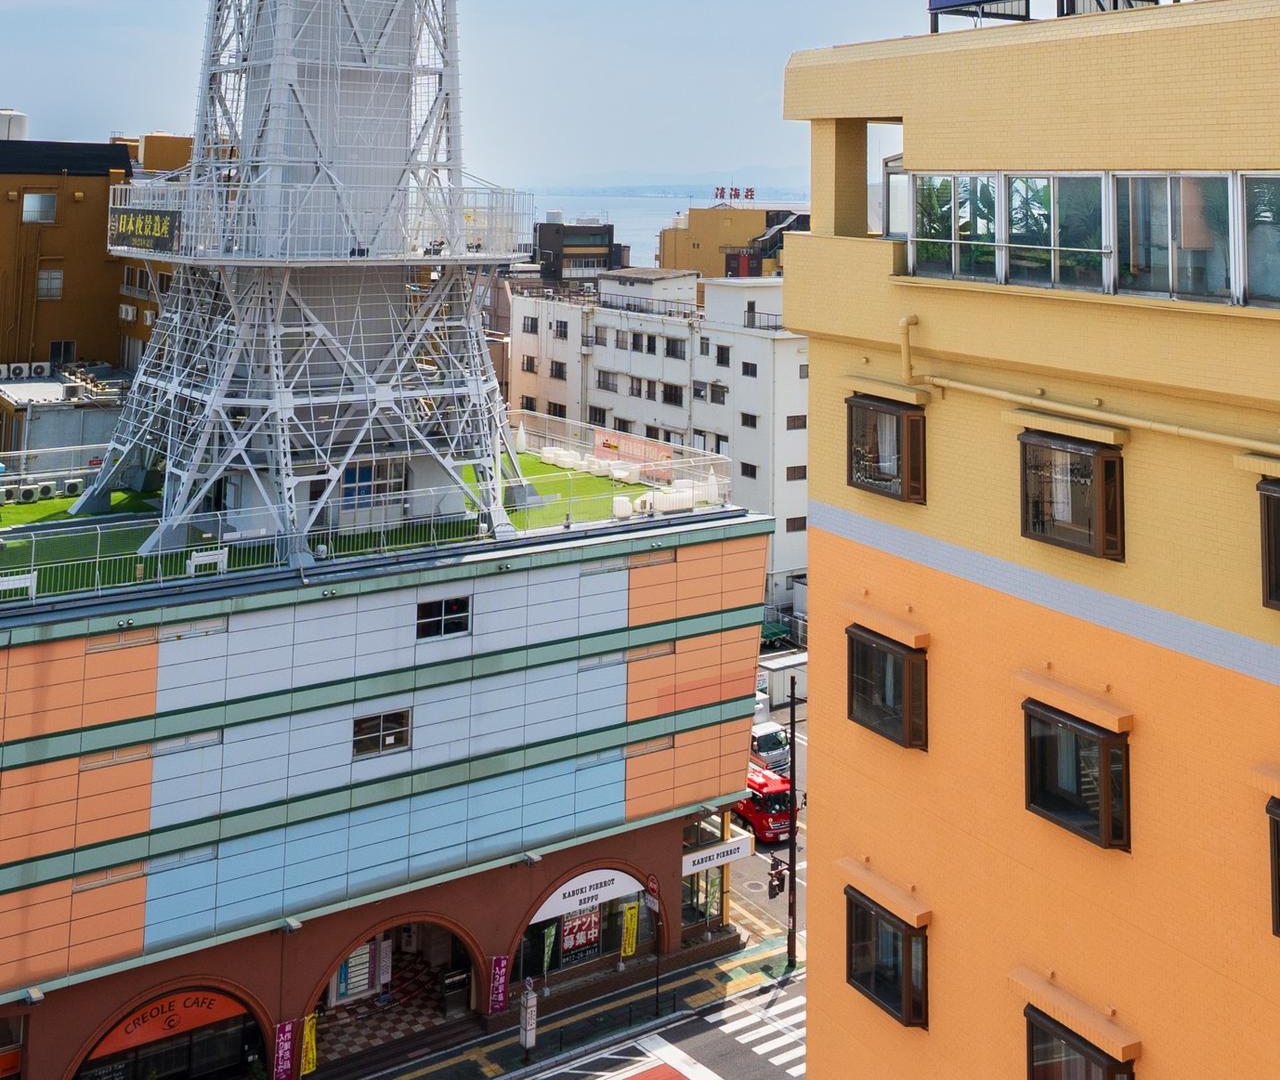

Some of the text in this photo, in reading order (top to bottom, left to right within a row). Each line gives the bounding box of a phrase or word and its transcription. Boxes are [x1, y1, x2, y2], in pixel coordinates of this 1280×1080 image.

[692, 846, 741, 867] KABUKI PIERROT
[562, 877, 616, 900] KABUKI PIERROT
[578, 893, 600, 906] BEPPU
[563, 913, 599, 936] テナント
[124, 1000, 176, 1035] CREOLE
[182, 997, 217, 1010] CAFE
